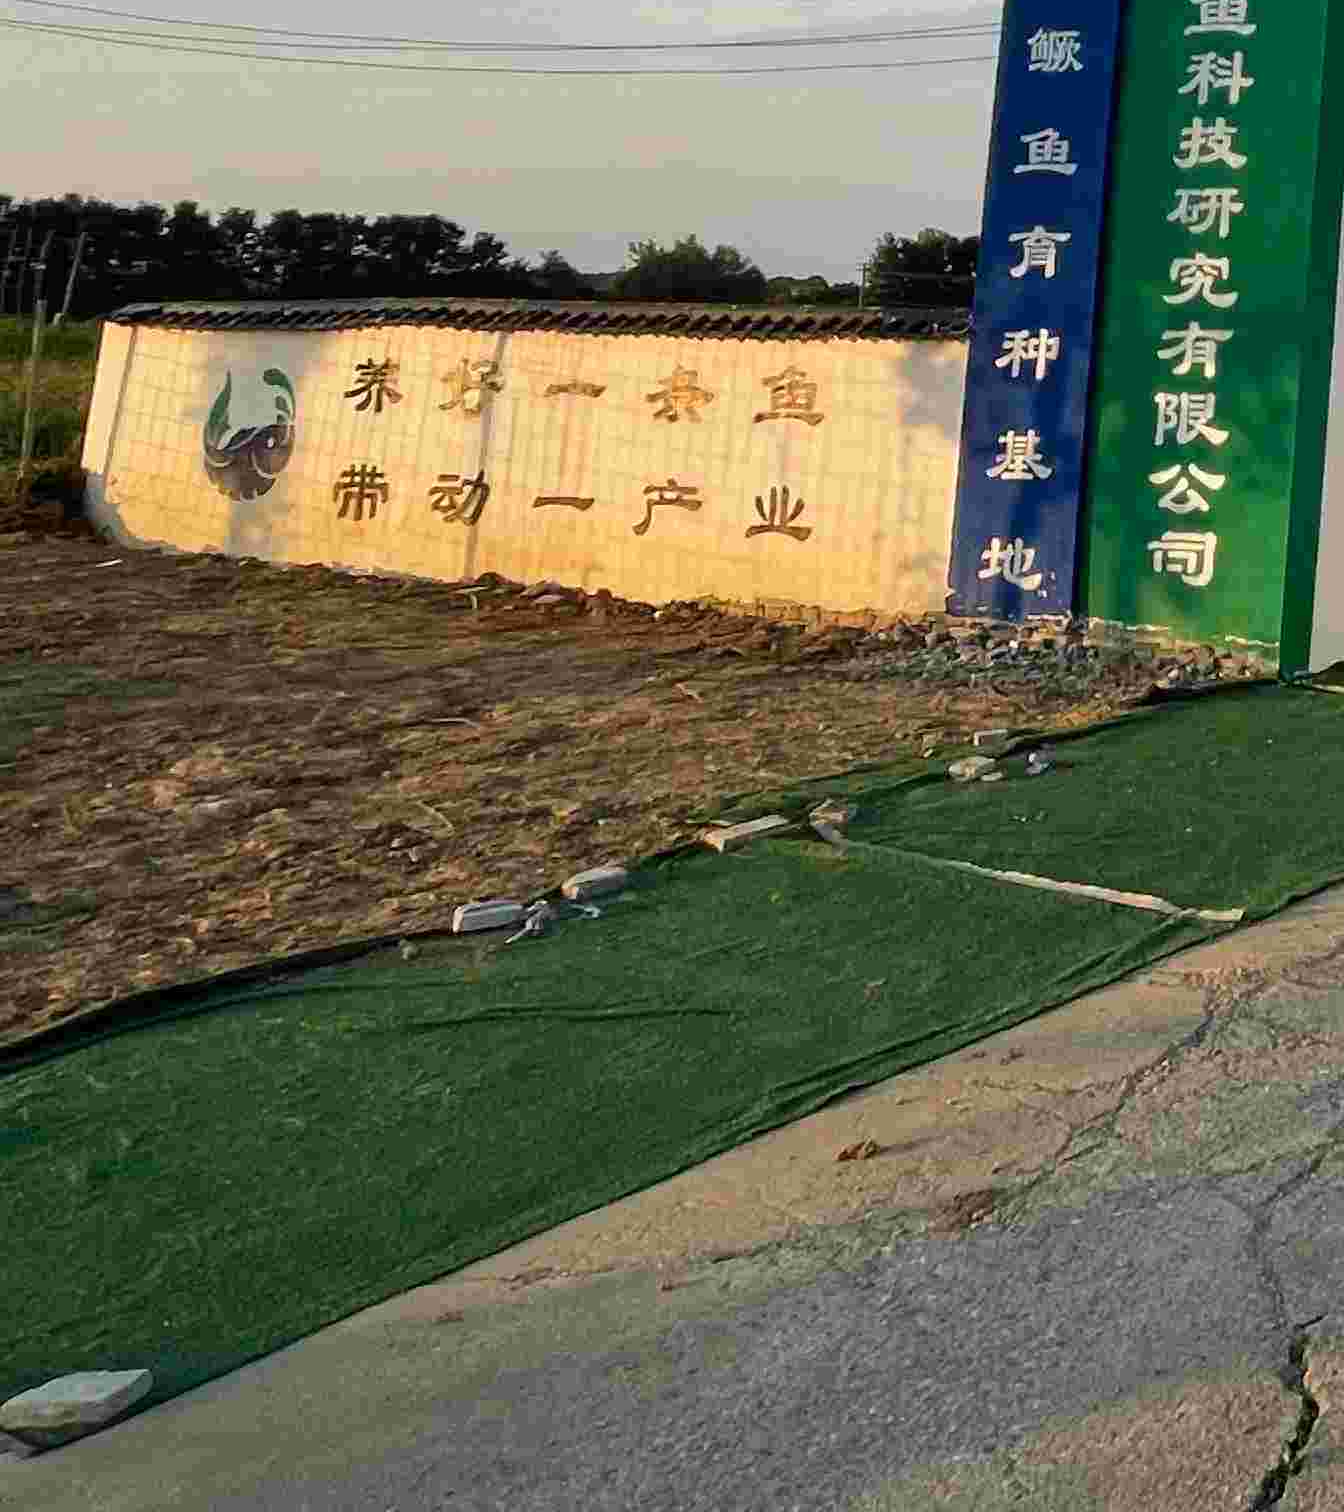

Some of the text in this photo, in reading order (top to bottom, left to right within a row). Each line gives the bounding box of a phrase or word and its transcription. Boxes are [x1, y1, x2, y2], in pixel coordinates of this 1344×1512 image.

[344, 357, 825, 426] 养好一条鱼
[333, 463, 812, 541] 带动一产业
